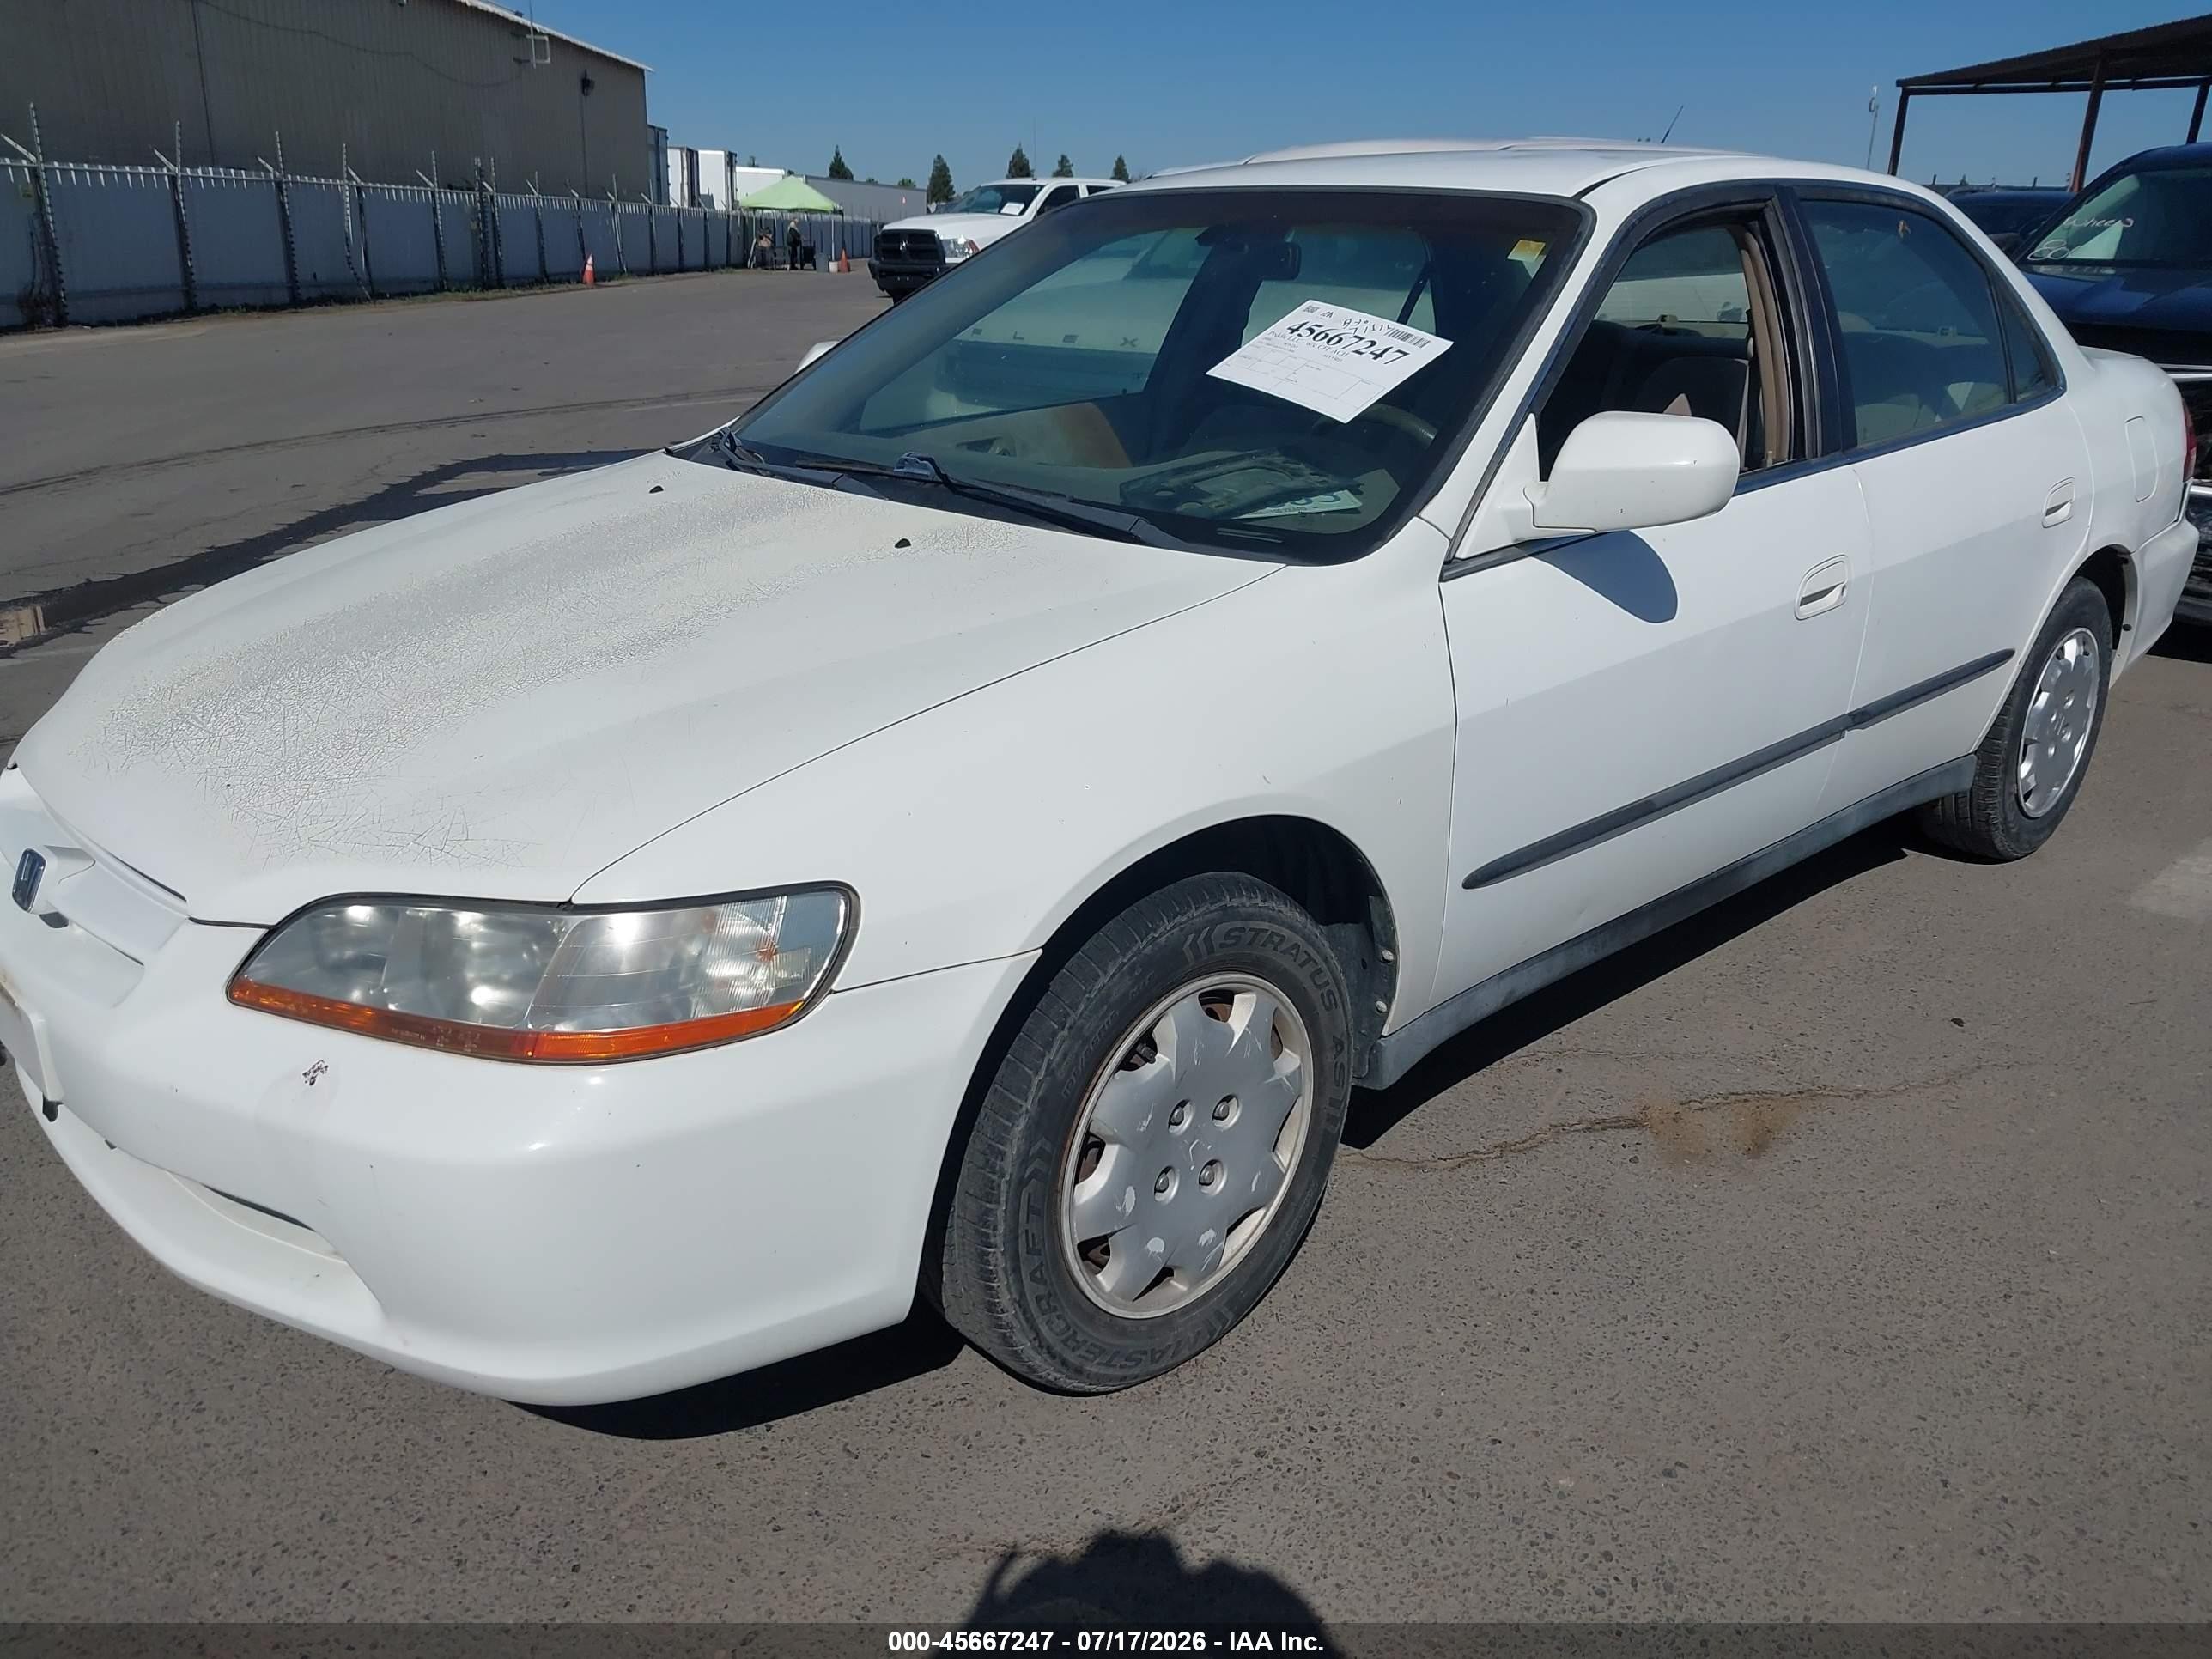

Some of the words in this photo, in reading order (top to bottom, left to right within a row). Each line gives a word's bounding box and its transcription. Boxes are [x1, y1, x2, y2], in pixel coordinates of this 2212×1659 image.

[971, 328, 1139, 348] FLEX
[1286, 320, 1411, 365] 45667247
[1218, 927, 1338, 1013] STRATUS
[1025, 1194, 1205, 1369] MASTERCRAFT
